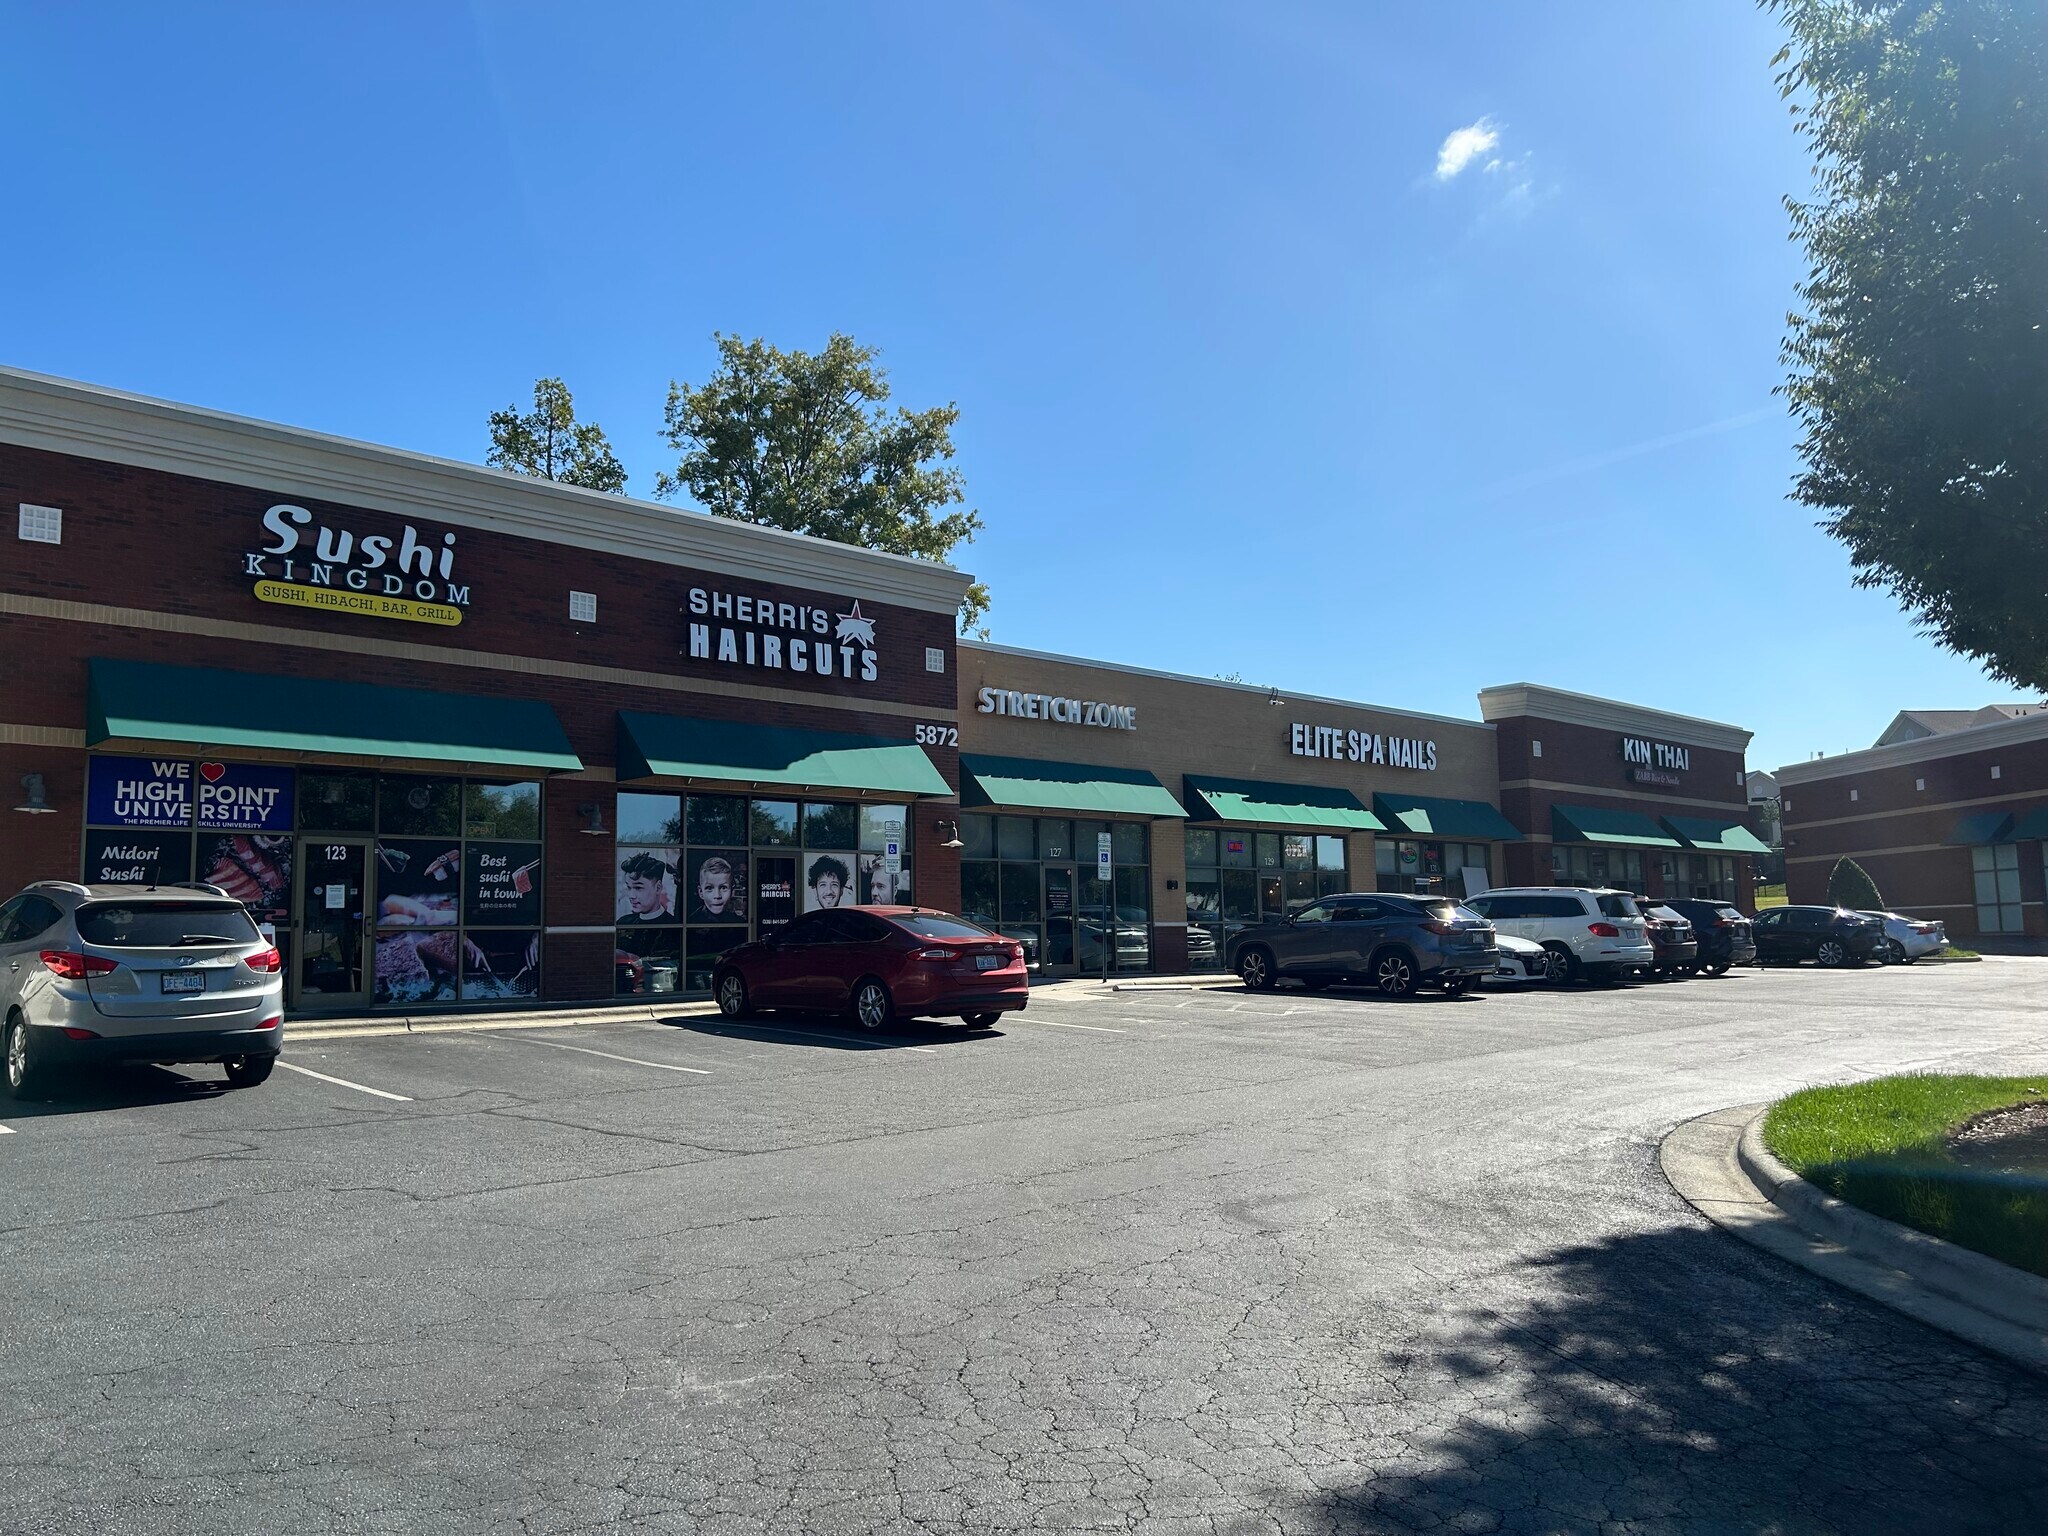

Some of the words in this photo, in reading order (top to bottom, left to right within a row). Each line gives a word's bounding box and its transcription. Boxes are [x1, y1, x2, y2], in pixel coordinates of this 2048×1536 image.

[262, 504, 457, 580] Sushi
[246, 553, 470, 605] KINGDOM
[263, 586, 309, 603] SUSHI,
[314, 592, 377, 613] HIBACHI,
[382, 602, 412, 616] BAR,
[417, 606, 455, 621] GRILL
[689, 588, 829, 634] SHERRI'S
[690, 623, 878, 681] HAIRCUTS
[977, 687, 1082, 724] STRETCH
[1082, 701, 1137, 731] ZONE
[914, 724, 959, 748] 5872
[1290, 723, 1343, 760] ELITE
[1347, 729, 1384, 765] SPA
[1388, 736, 1437, 771] NAILS
[1623, 737, 1652, 764] KIN
[1655, 743, 1689, 771] THAI
[152, 761, 190, 778] WE
[117, 780, 184, 802] HIGH
[200, 785, 280, 806] POINT
[114, 800, 272, 821] UNIVERSITY
[140, 818, 171, 826] PREMIER
[101, 846, 160, 860] Midori
[325, 845, 347, 860] 123
[1050, 847, 1062, 857] 127
[1285, 844, 1308, 857] OPEN
[480, 854, 507, 867] Best
[1264, 857, 1275, 866] 129
[100, 866, 146, 881] Sushi
[480, 870, 511, 883] sushi
[479, 886, 491, 898] in
[494, 887, 523, 899] town
